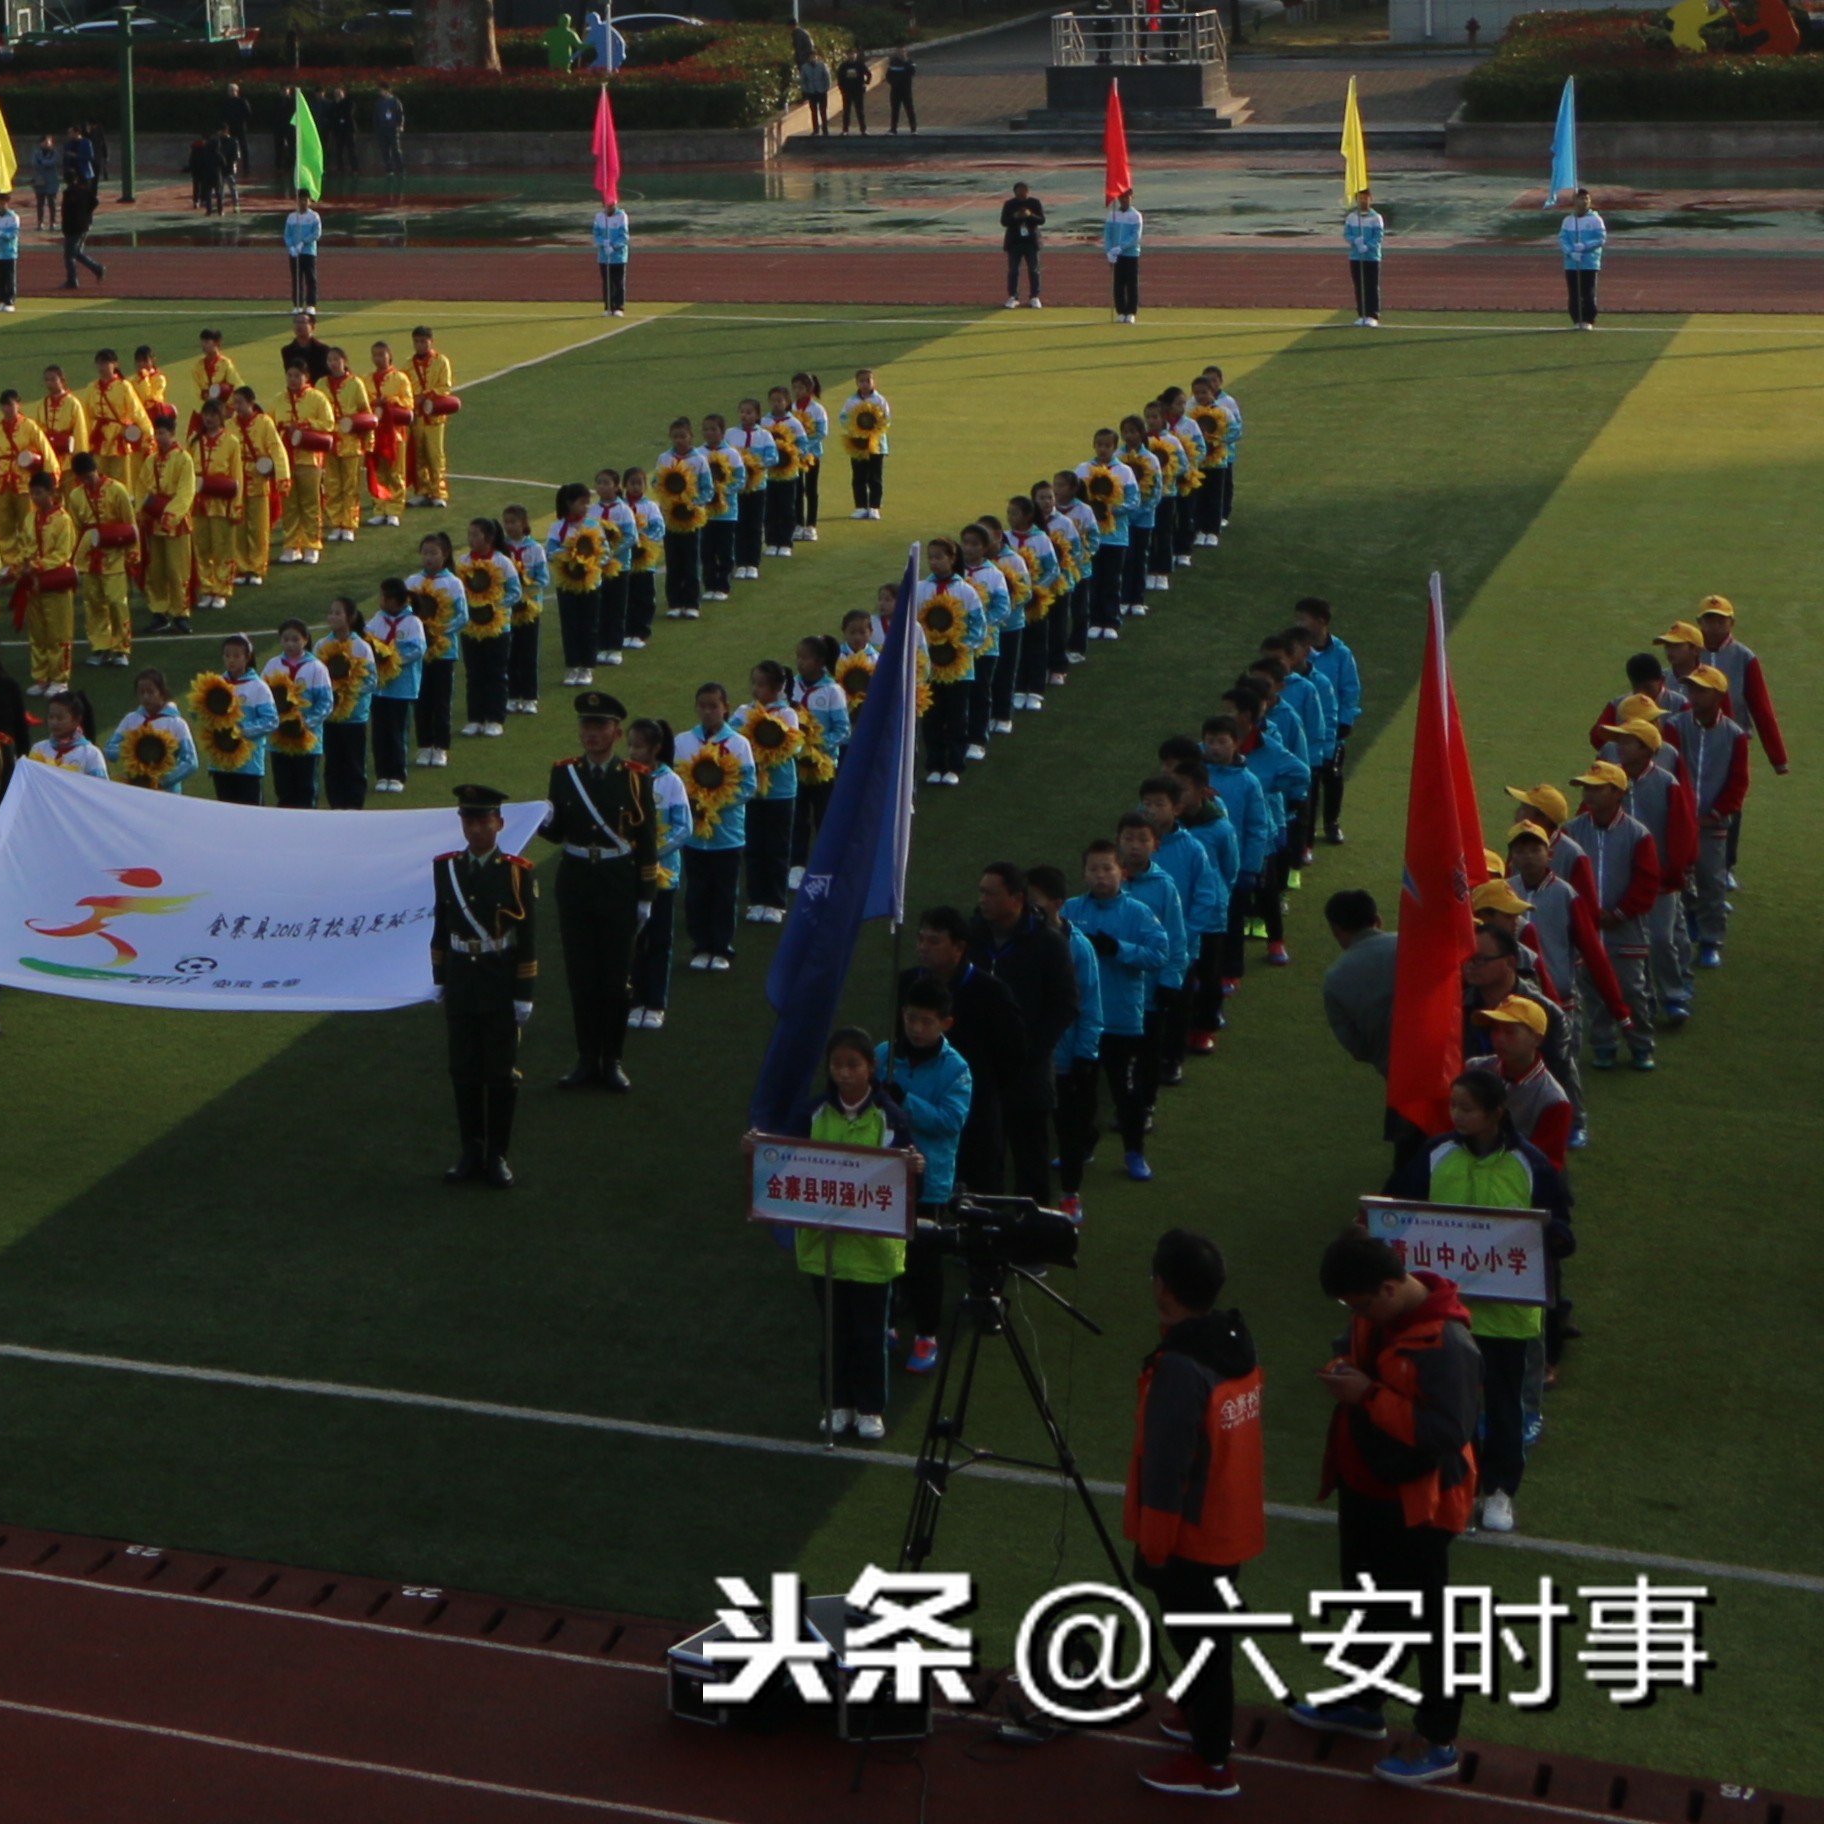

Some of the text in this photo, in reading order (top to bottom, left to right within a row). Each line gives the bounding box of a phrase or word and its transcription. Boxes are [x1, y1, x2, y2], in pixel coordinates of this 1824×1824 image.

[767, 1173, 894, 1212] 金寨县明强小学
[402, 1586, 442, 1598] 22
[1721, 1784, 1754, 1800] 18
